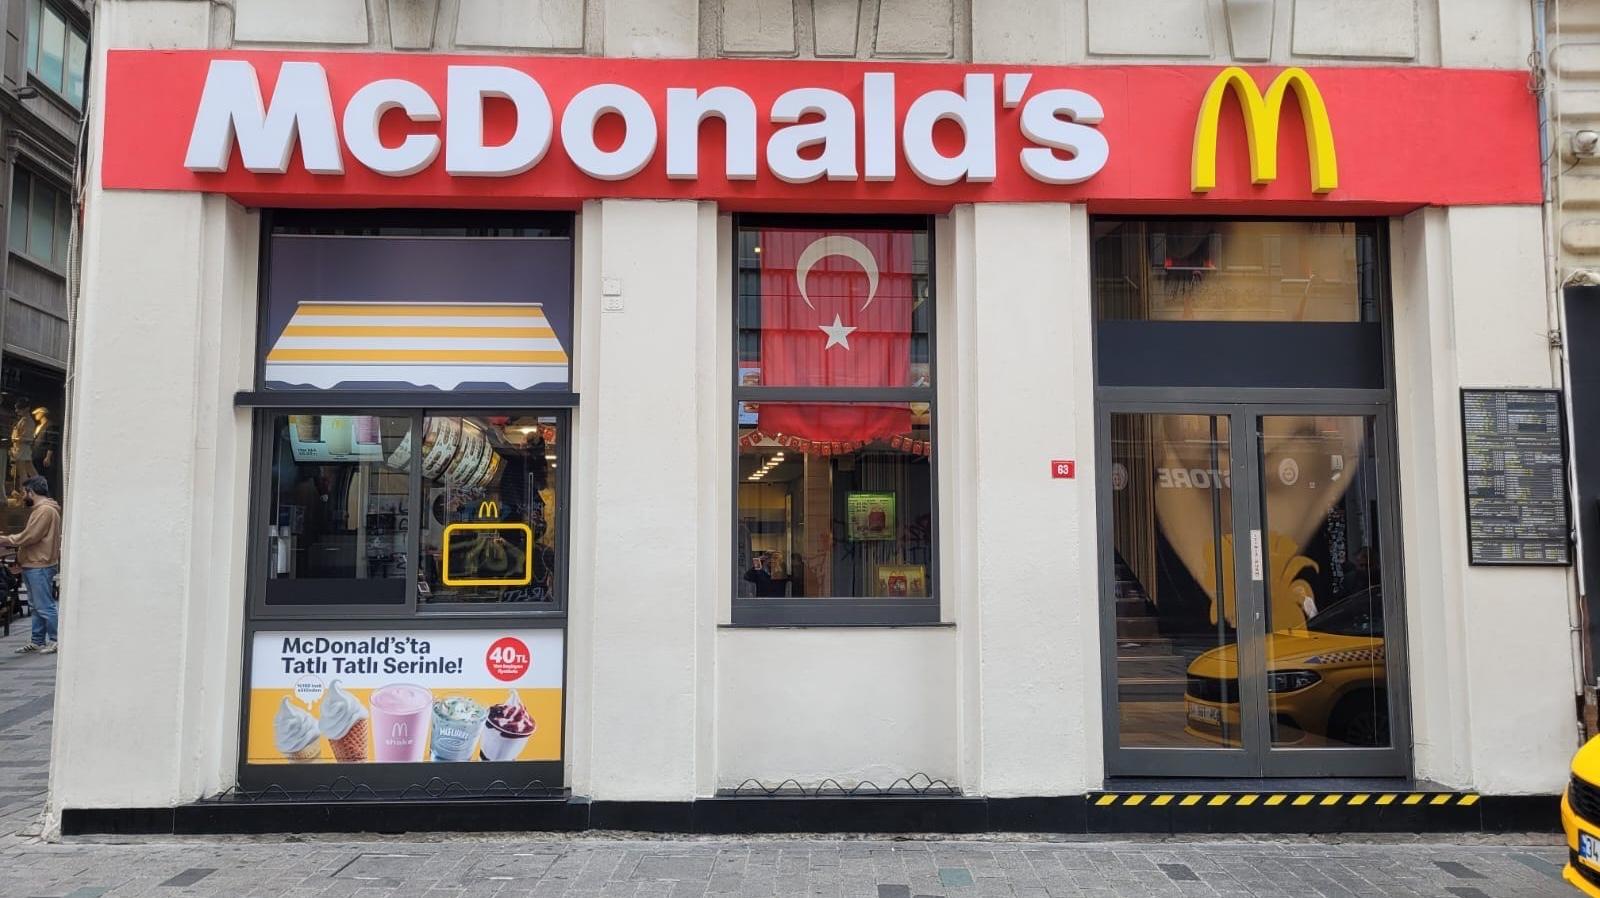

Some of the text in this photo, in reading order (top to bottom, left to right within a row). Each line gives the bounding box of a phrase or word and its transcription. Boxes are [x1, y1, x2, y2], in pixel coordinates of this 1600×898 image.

[184, 59, 1109, 185] McDonald's
[1057, 464, 1069, 475] 63
[282, 637, 430, 654] McDonald's'ta
[281, 656, 463, 674] Tatlı Tatlı Serinle!
